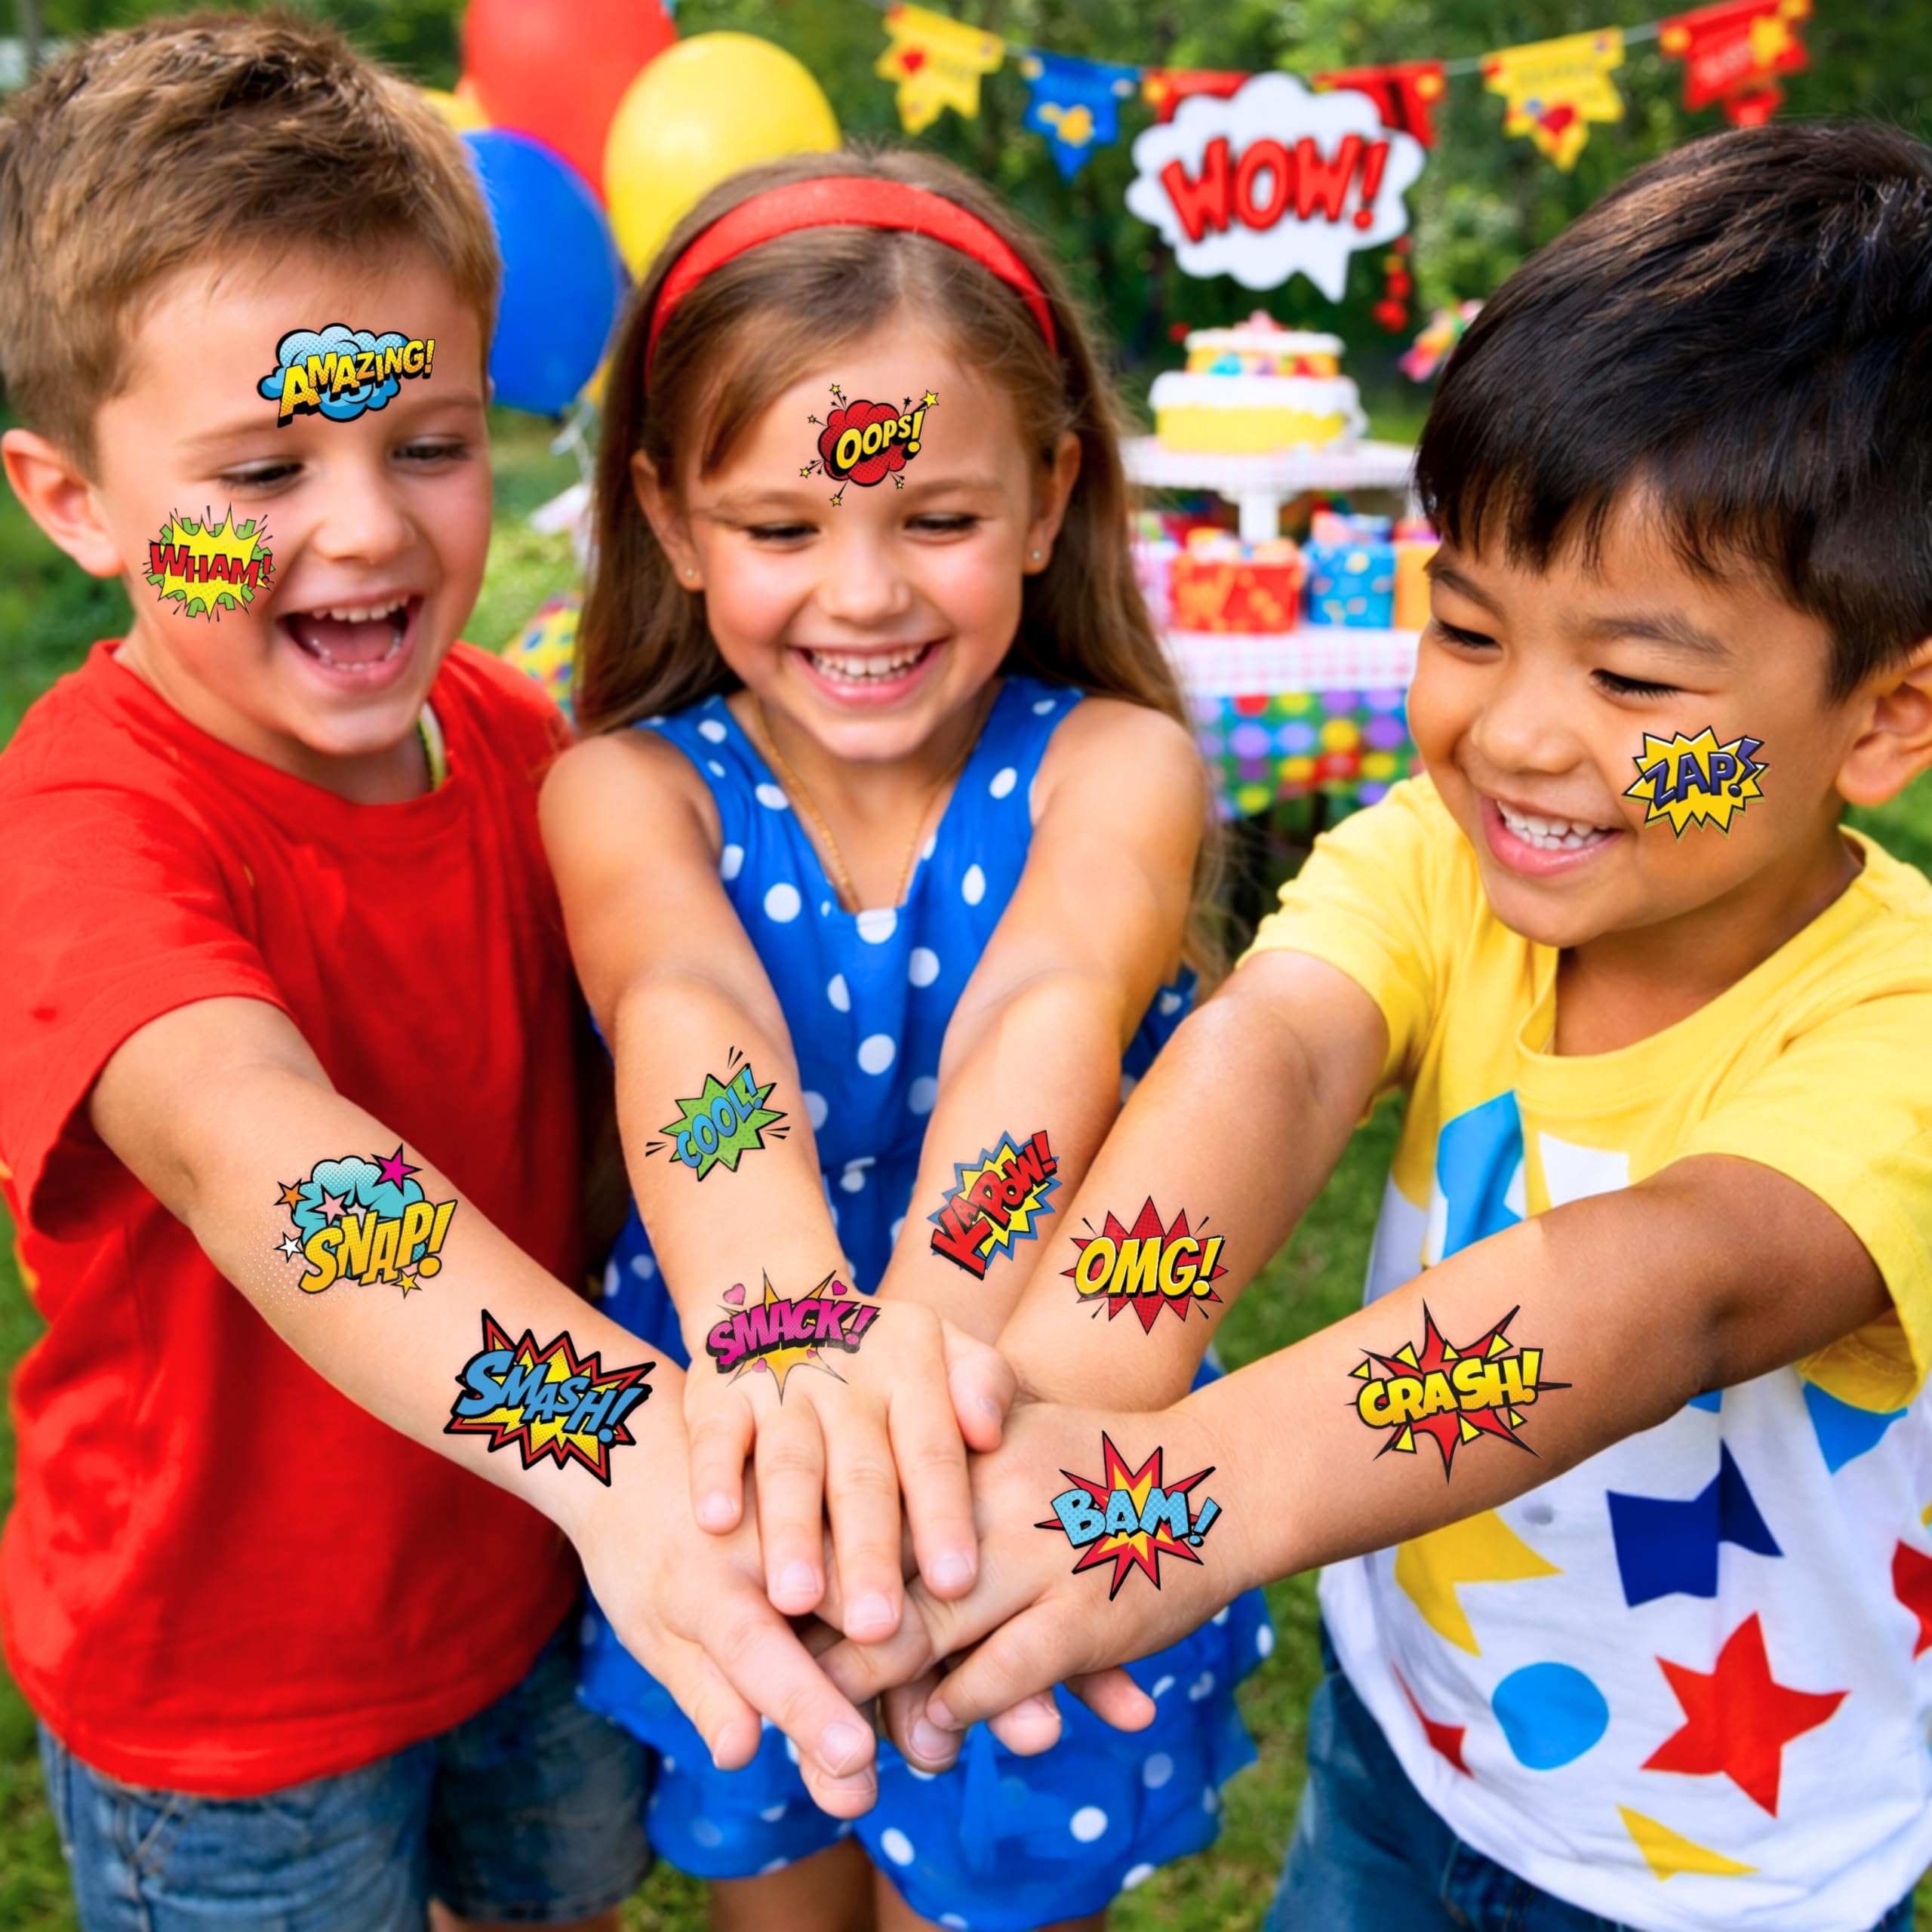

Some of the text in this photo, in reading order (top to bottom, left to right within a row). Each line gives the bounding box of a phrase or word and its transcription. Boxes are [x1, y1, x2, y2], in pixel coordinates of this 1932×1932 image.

[1158, 134, 1389, 244] WOW!
[278, 339, 435, 428] AMAZING!
[831, 409, 926, 476] OOPS!
[149, 543, 272, 589] WHAM!
[1643, 735, 1764, 811] ZAP!
[676, 1066, 764, 1168] COOL!
[298, 1199, 458, 1294] SNAP!
[930, 1130, 1057, 1281] KAPOW!
[1075, 1235, 1225, 1300] OMG!
[706, 1297, 881, 1374] SMACK!
[453, 1349, 649, 1444] SMASH!
[1356, 1347, 1543, 1429] CRASH!
[1050, 1486, 1223, 1549] BAM!
